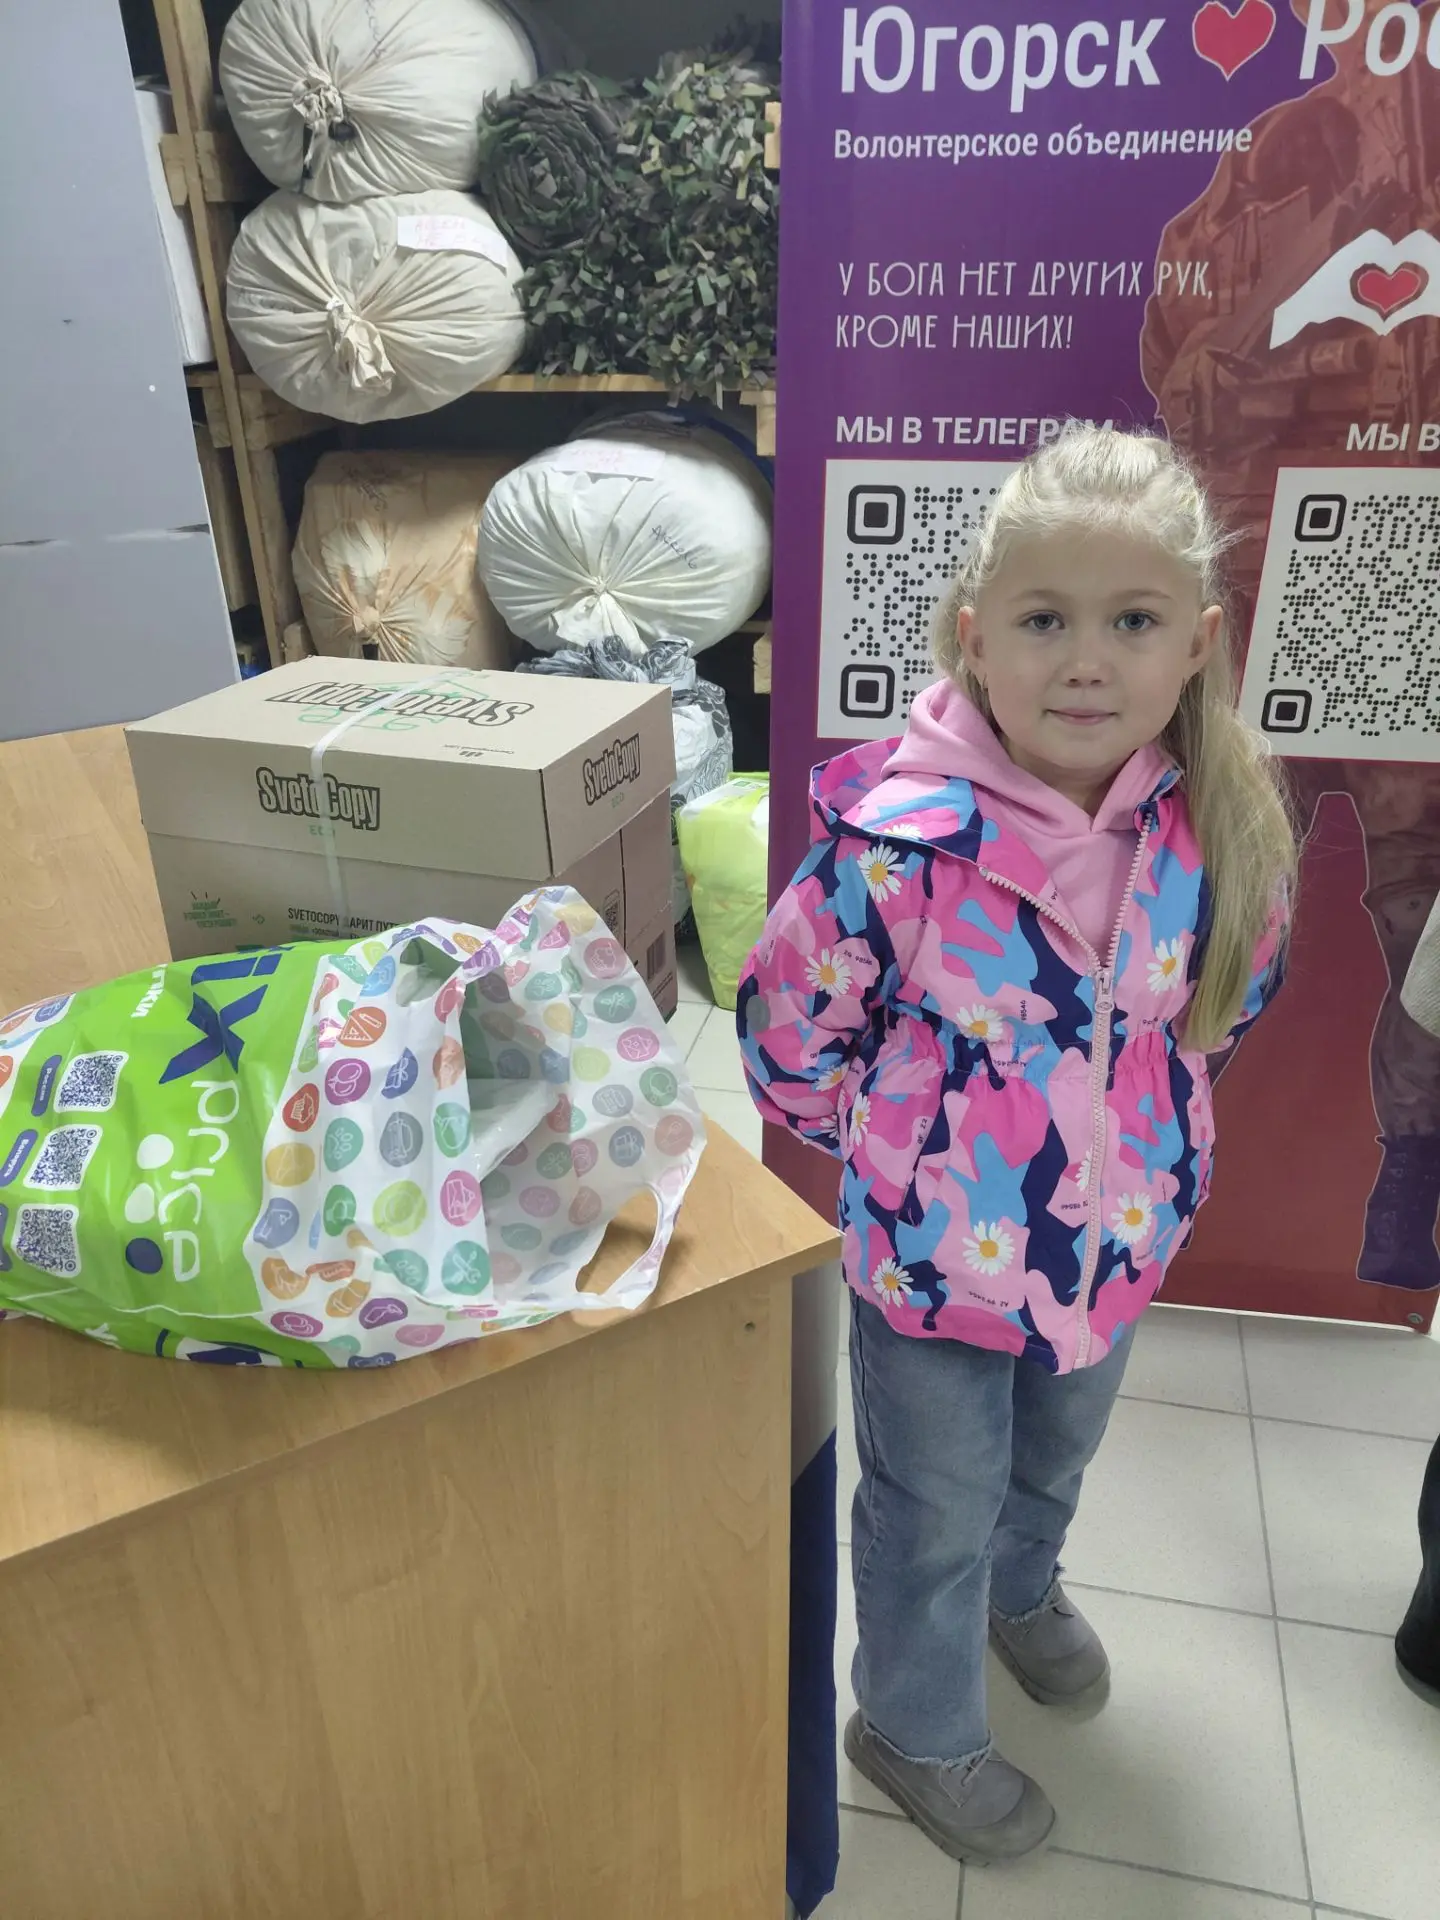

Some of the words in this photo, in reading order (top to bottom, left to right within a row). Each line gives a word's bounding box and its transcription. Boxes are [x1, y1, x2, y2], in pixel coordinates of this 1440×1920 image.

[840, 5, 1163, 113] Югорск
[1299, 0, 1440, 81] Ро
[833, 127, 1039, 165] Волонтерское
[1046, 124, 1253, 160] объединение
[837, 263, 855, 297] У
[867, 262, 946, 297] БОГА
[958, 262, 1018, 297] НЕТ
[1027, 261, 1143, 297] ДРУГИХ
[1156, 261, 1214, 301] РУК,
[834, 315, 939, 350] КРОМЕ
[951, 315, 1074, 350] НАШИХ!
[835, 415, 893, 444] МЫ
[901, 416, 923, 445] В
[1346, 423, 1410, 451] МЫ
[265, 681, 535, 727] SvetoCopy
[583, 732, 642, 806] SvetoCopy
[256, 766, 381, 831] SvetoCopy
[157, 1079, 241, 1283] price
